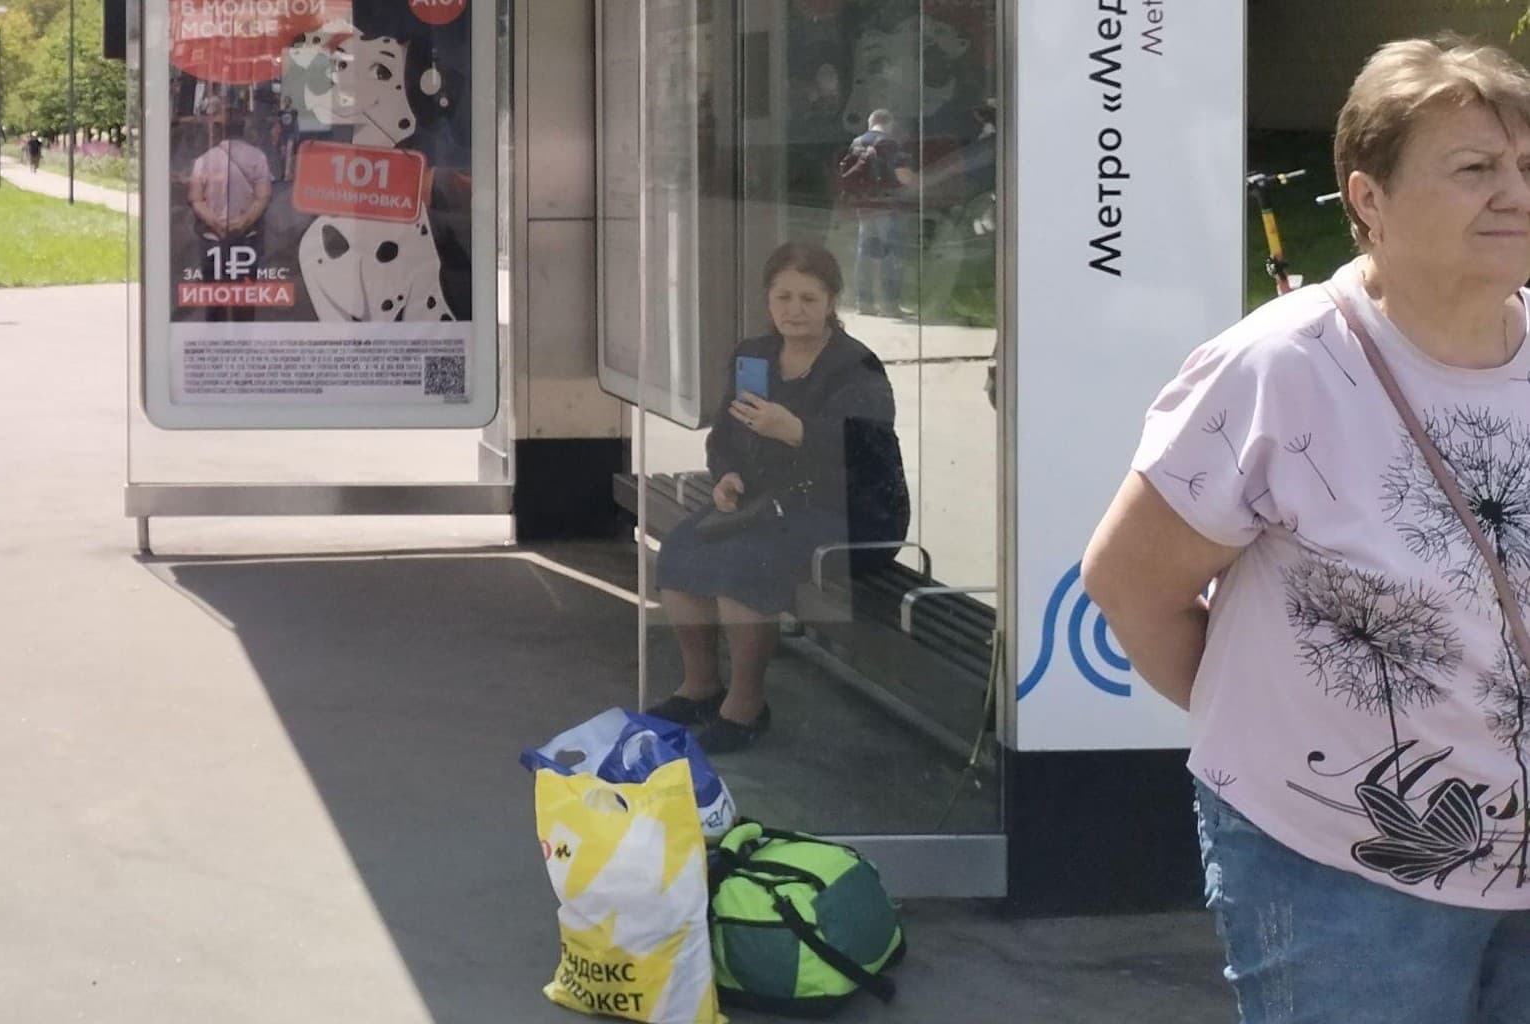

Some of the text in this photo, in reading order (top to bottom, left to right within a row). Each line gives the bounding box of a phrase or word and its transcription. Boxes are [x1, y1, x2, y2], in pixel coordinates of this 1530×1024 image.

[181, 0, 195, 17] В
[332, 155, 389, 189] 101
[1088, 127, 1130, 277] Метро
[183, 267, 203, 280] ЗА
[182, 286, 290, 303] ИПОТЕКА
